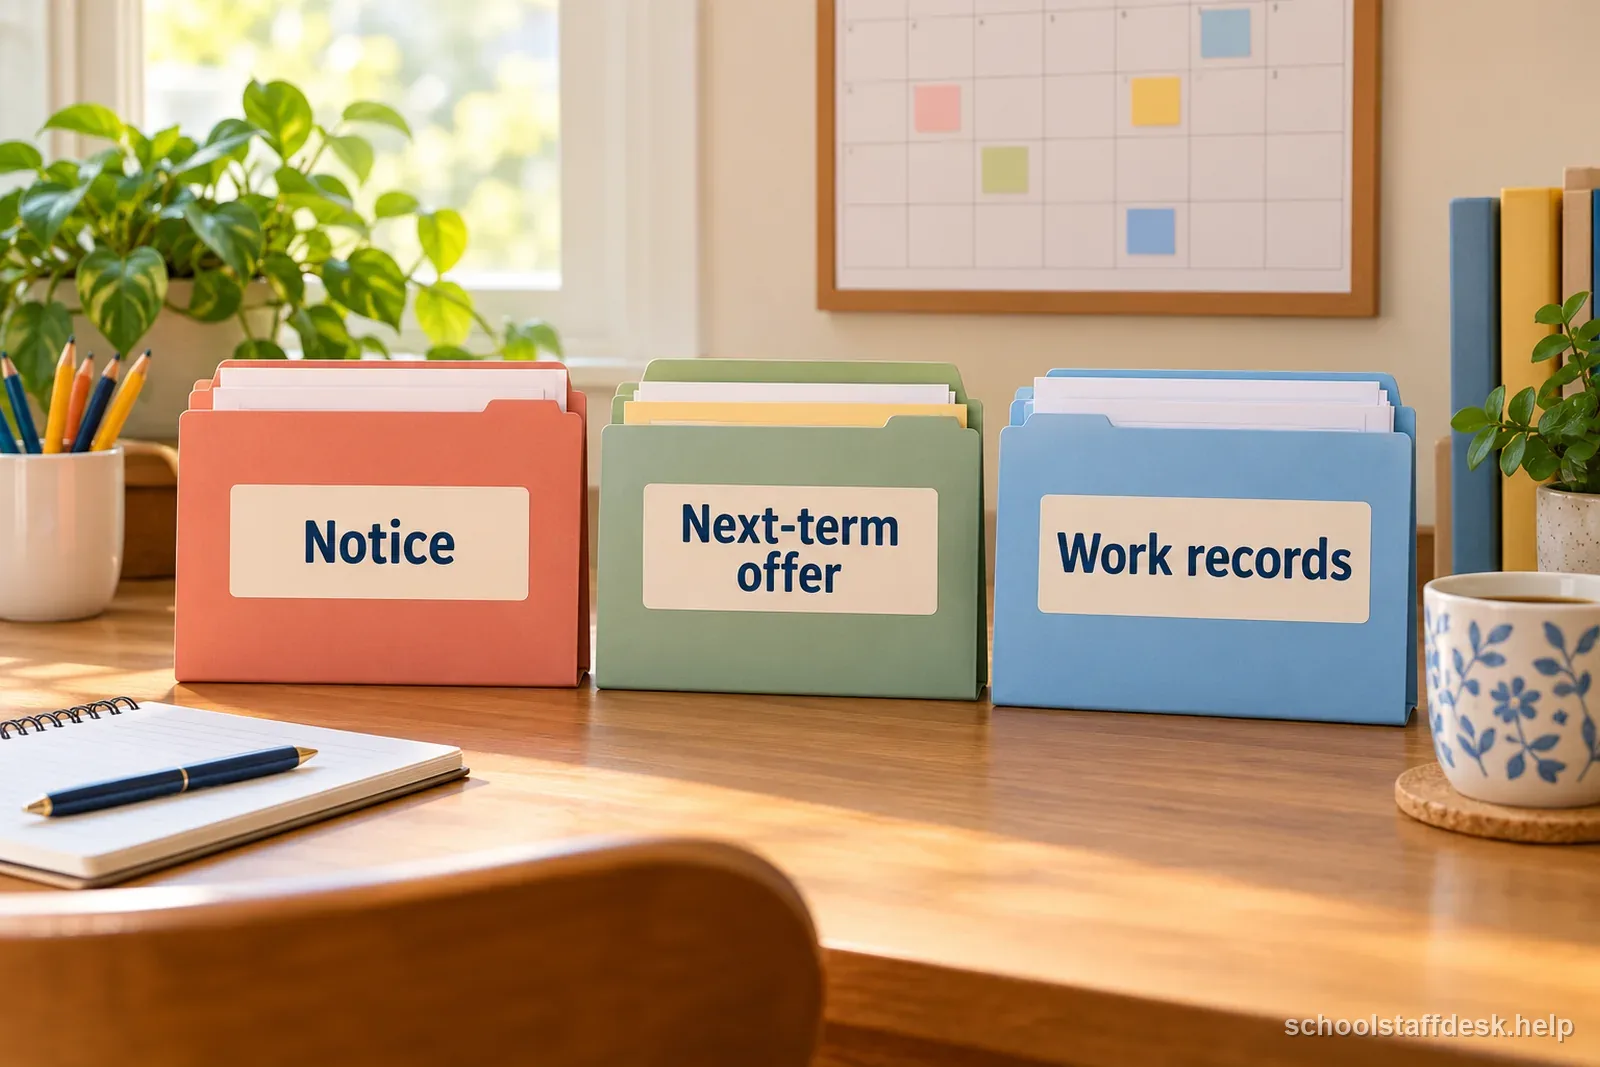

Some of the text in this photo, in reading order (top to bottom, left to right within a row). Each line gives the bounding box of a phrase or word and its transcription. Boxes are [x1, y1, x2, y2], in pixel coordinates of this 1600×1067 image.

[305, 518, 456, 565] Notice
[682, 503, 899, 547] Next-term
[737, 550, 842, 594] offer
[1057, 531, 1352, 582] Work records
